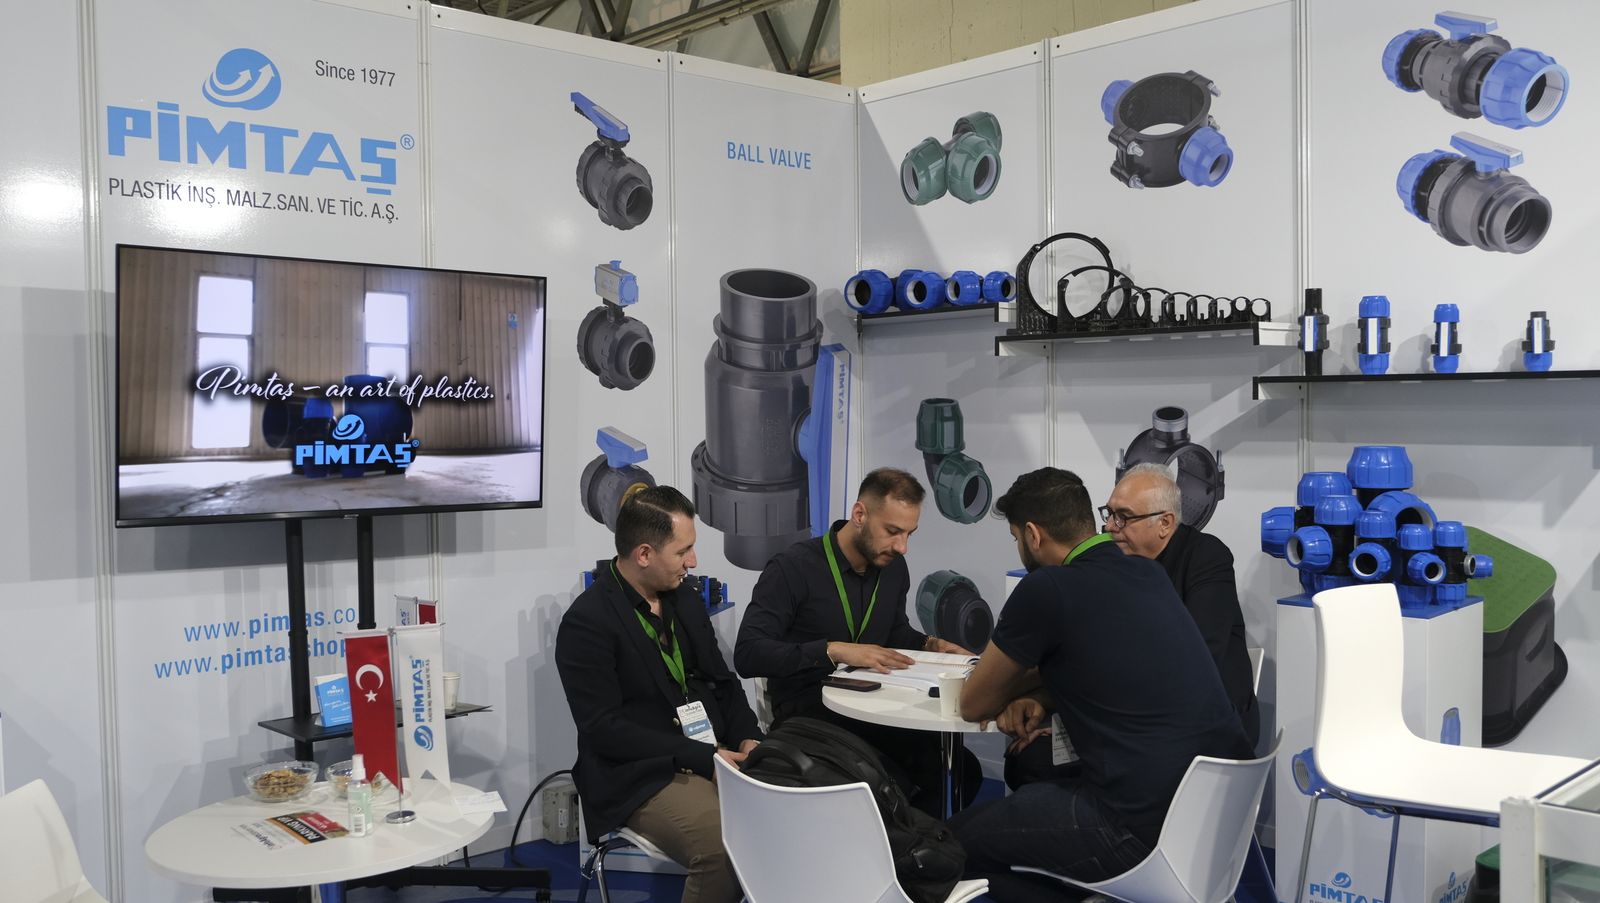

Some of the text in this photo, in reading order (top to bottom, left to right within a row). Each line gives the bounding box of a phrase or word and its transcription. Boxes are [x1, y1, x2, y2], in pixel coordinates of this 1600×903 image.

[315, 59, 396, 87] Since 1977
[727, 141, 812, 170] BALL VALVE
[108, 177, 399, 224] PLASTİK İNŞ. MALZ.SAN. VE TİC. A.Ş.
[195, 365, 295, 401] Pimtaş
[325, 383, 353, 398] an
[359, 375, 397, 398] art
[399, 374, 423, 406] of
[417, 375, 495, 408] plastics.
